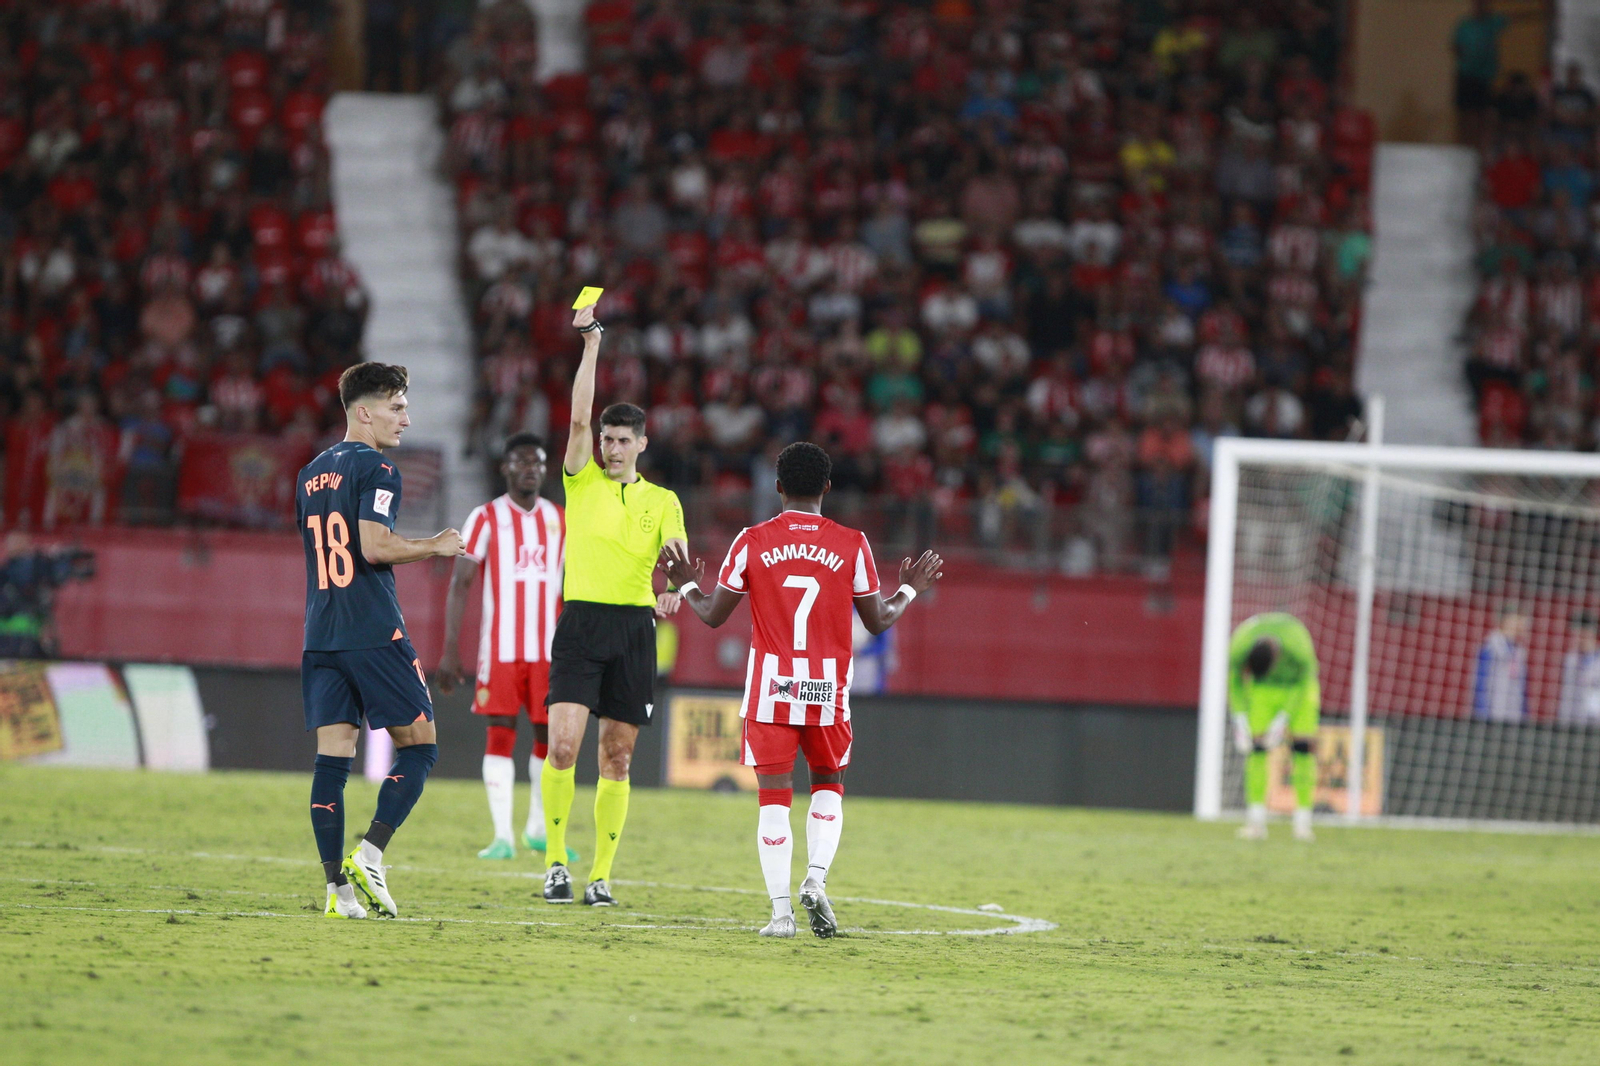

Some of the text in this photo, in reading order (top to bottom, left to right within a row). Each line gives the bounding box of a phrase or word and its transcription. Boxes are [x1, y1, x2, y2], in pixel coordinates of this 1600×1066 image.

[307, 511, 354, 590] 18
[760, 543, 845, 573] RAMAZANI
[782, 575, 820, 650] 7
[799, 691, 832, 702] HORSE
[801, 680, 833, 692] POWER
